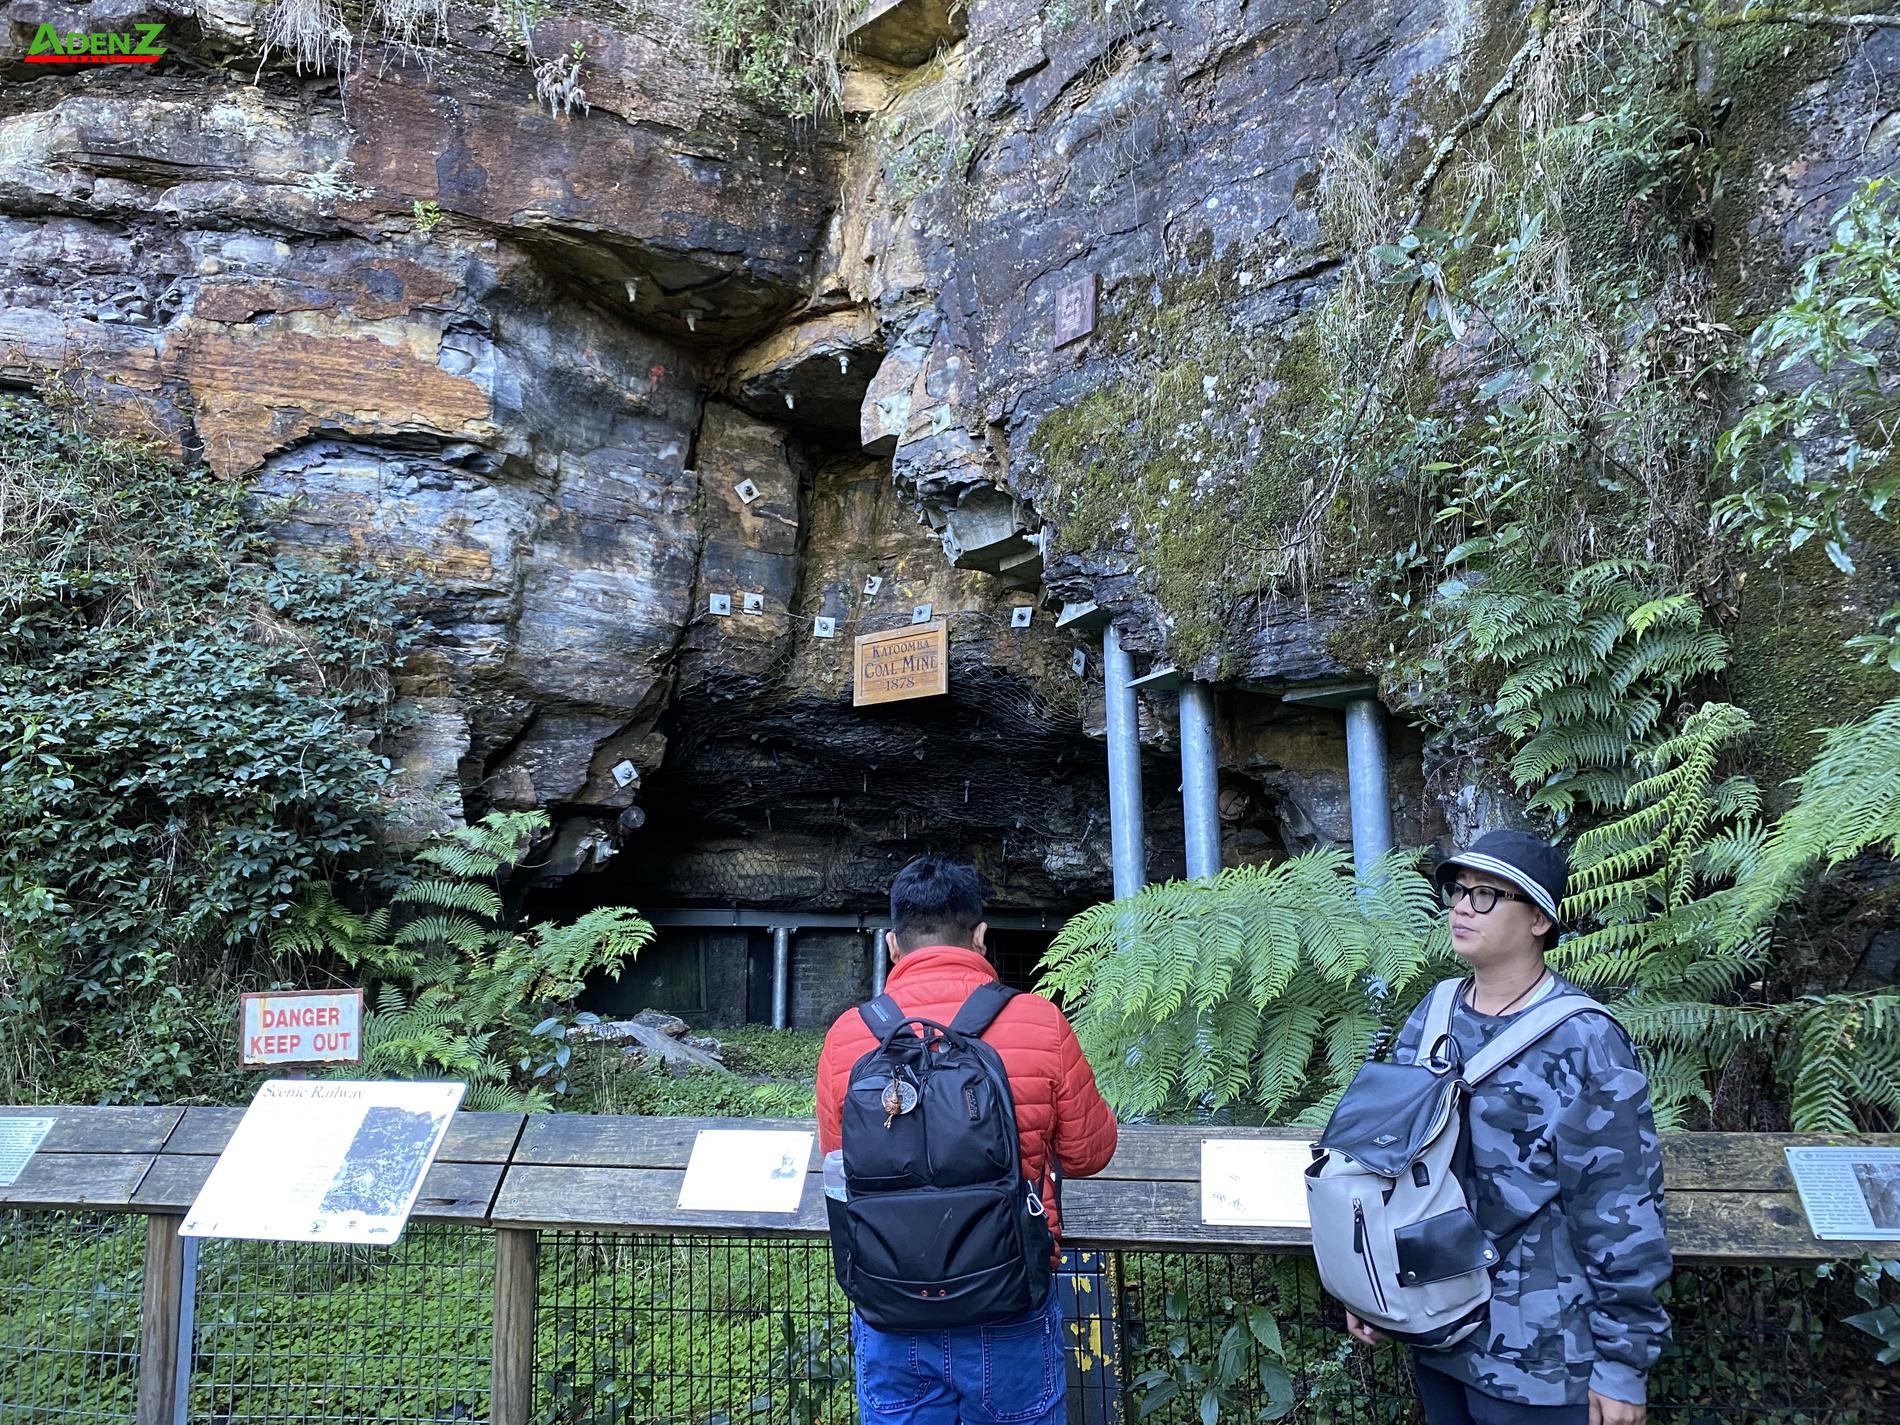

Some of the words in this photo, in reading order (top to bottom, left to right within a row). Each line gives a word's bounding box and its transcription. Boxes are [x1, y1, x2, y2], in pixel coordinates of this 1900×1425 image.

[872, 640, 930, 659] KATOOMBA
[864, 661, 898, 679] COAL
[902, 654, 938, 673] MINE
[886, 676, 915, 691] 1878
[262, 1007, 340, 1029] DANGER
[250, 1034, 302, 1055] KEEP
[313, 1032, 352, 1052] OUT
[263, 1085, 306, 1099] Scenic
